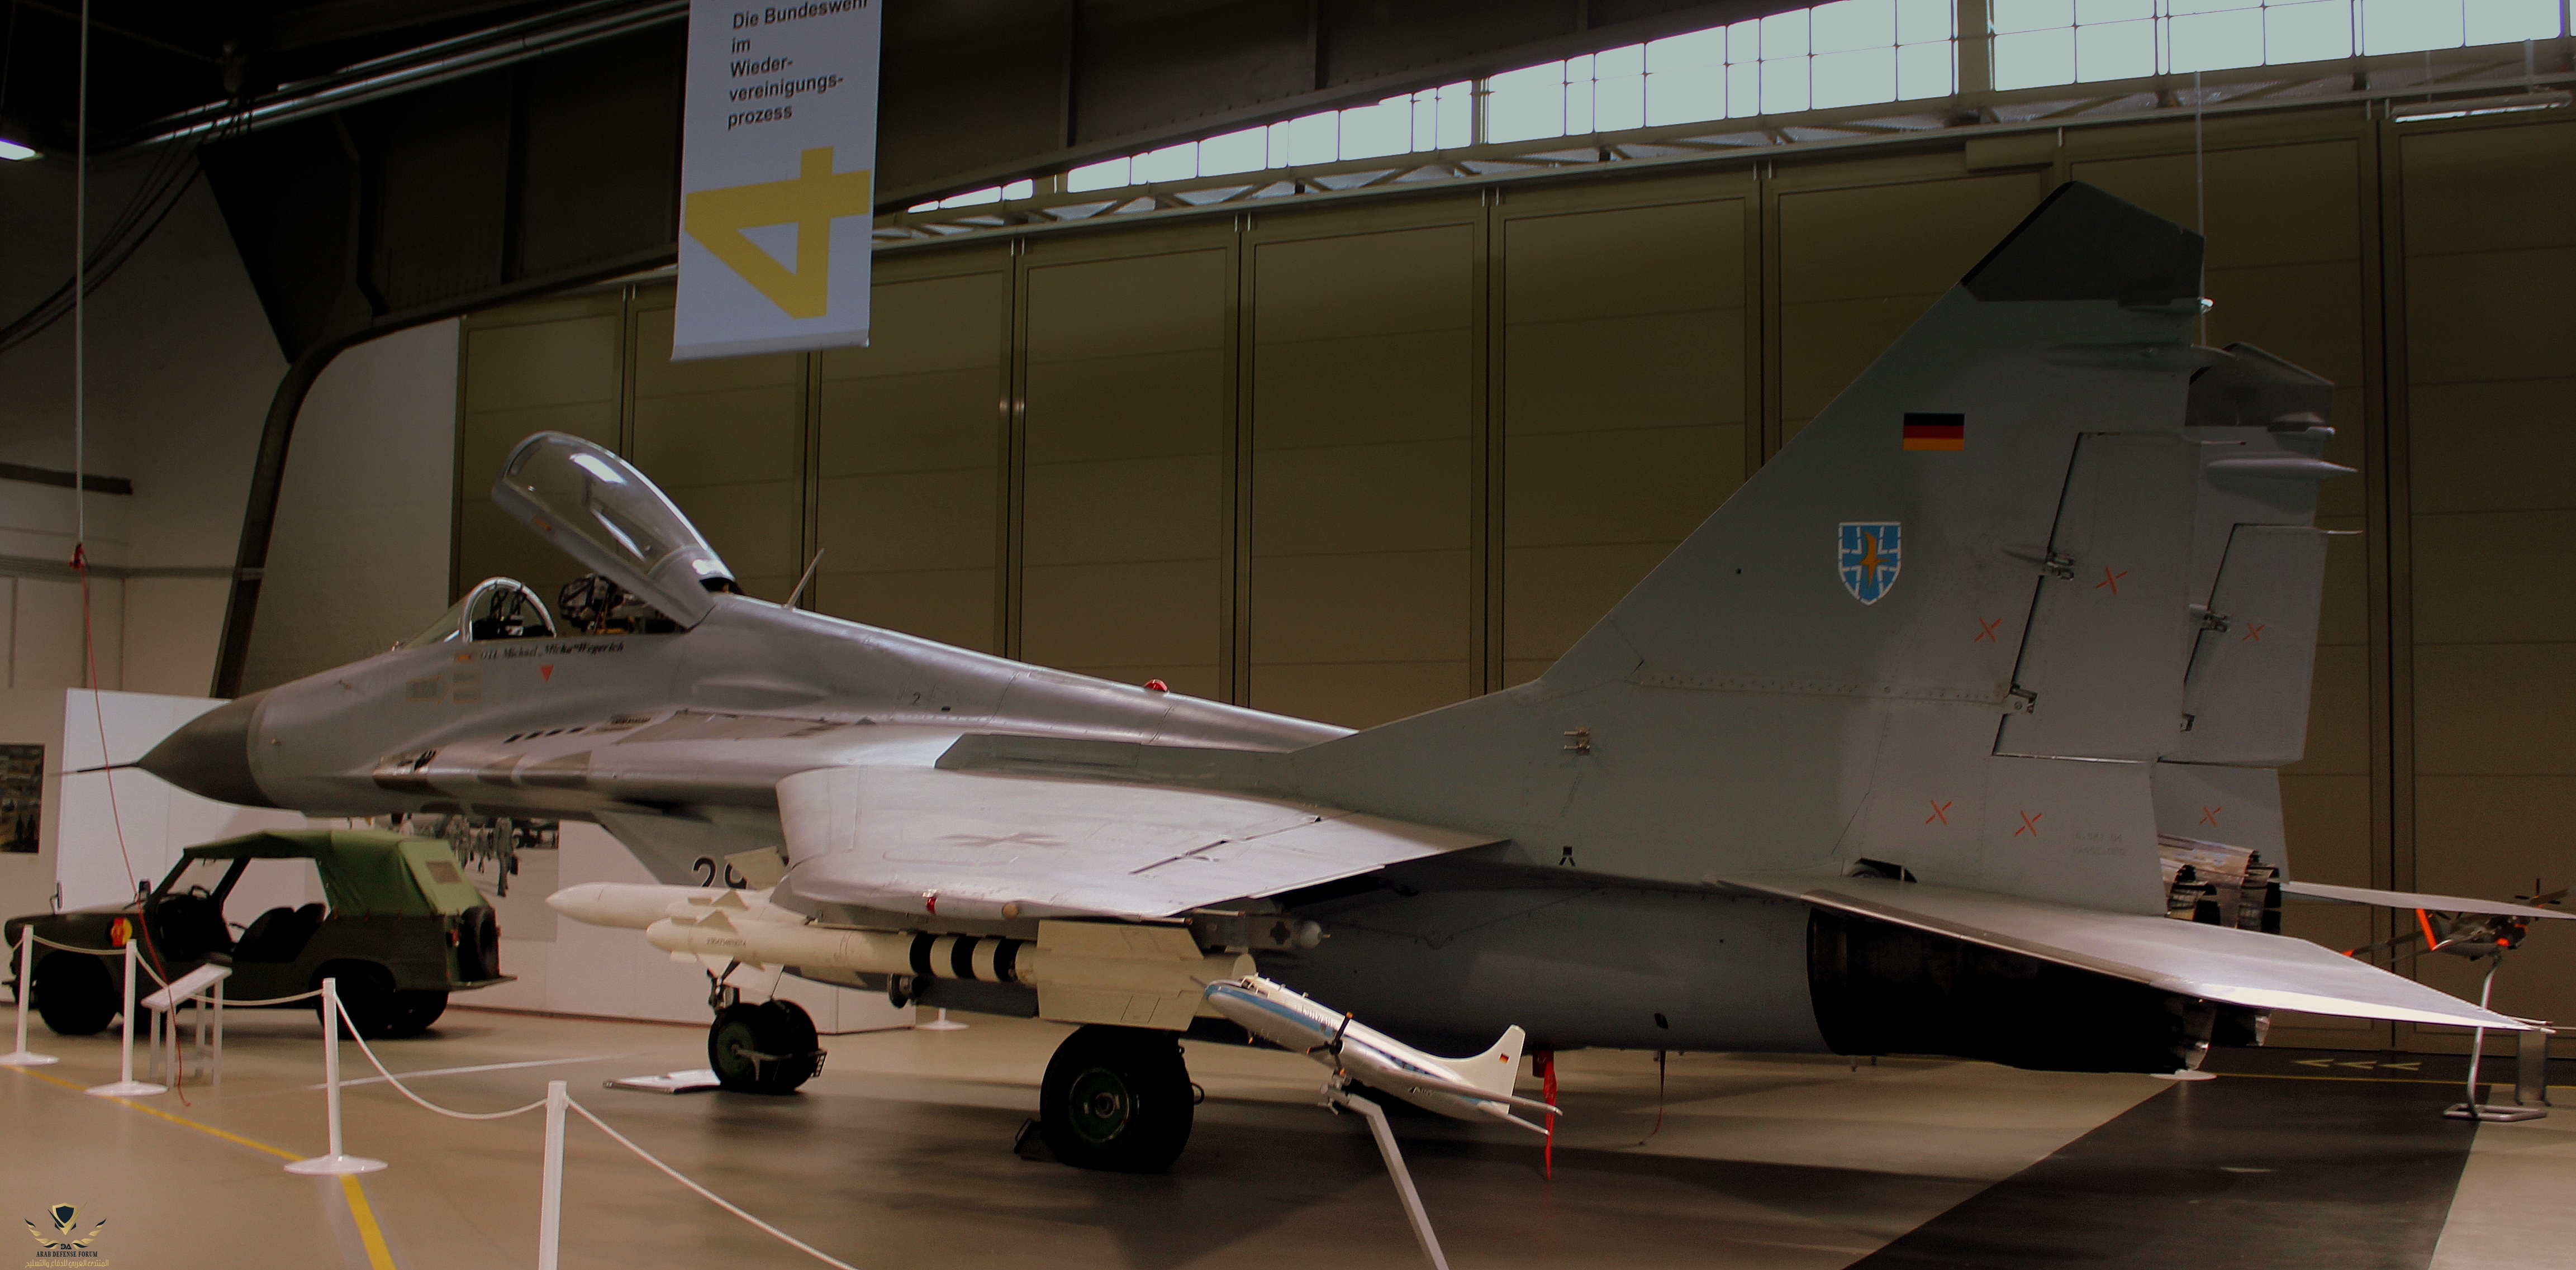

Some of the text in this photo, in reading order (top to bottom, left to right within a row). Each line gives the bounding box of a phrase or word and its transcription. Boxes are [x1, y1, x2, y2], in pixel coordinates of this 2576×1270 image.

[733, 0, 868, 29] Die Bundeswehr
[731, 37, 751, 54] im
[730, 56, 793, 77] Wieder-
[729, 74, 844, 102] vereinigungs-
[728, 106, 792, 131] prozess
[684, 146, 872, 319] 4
